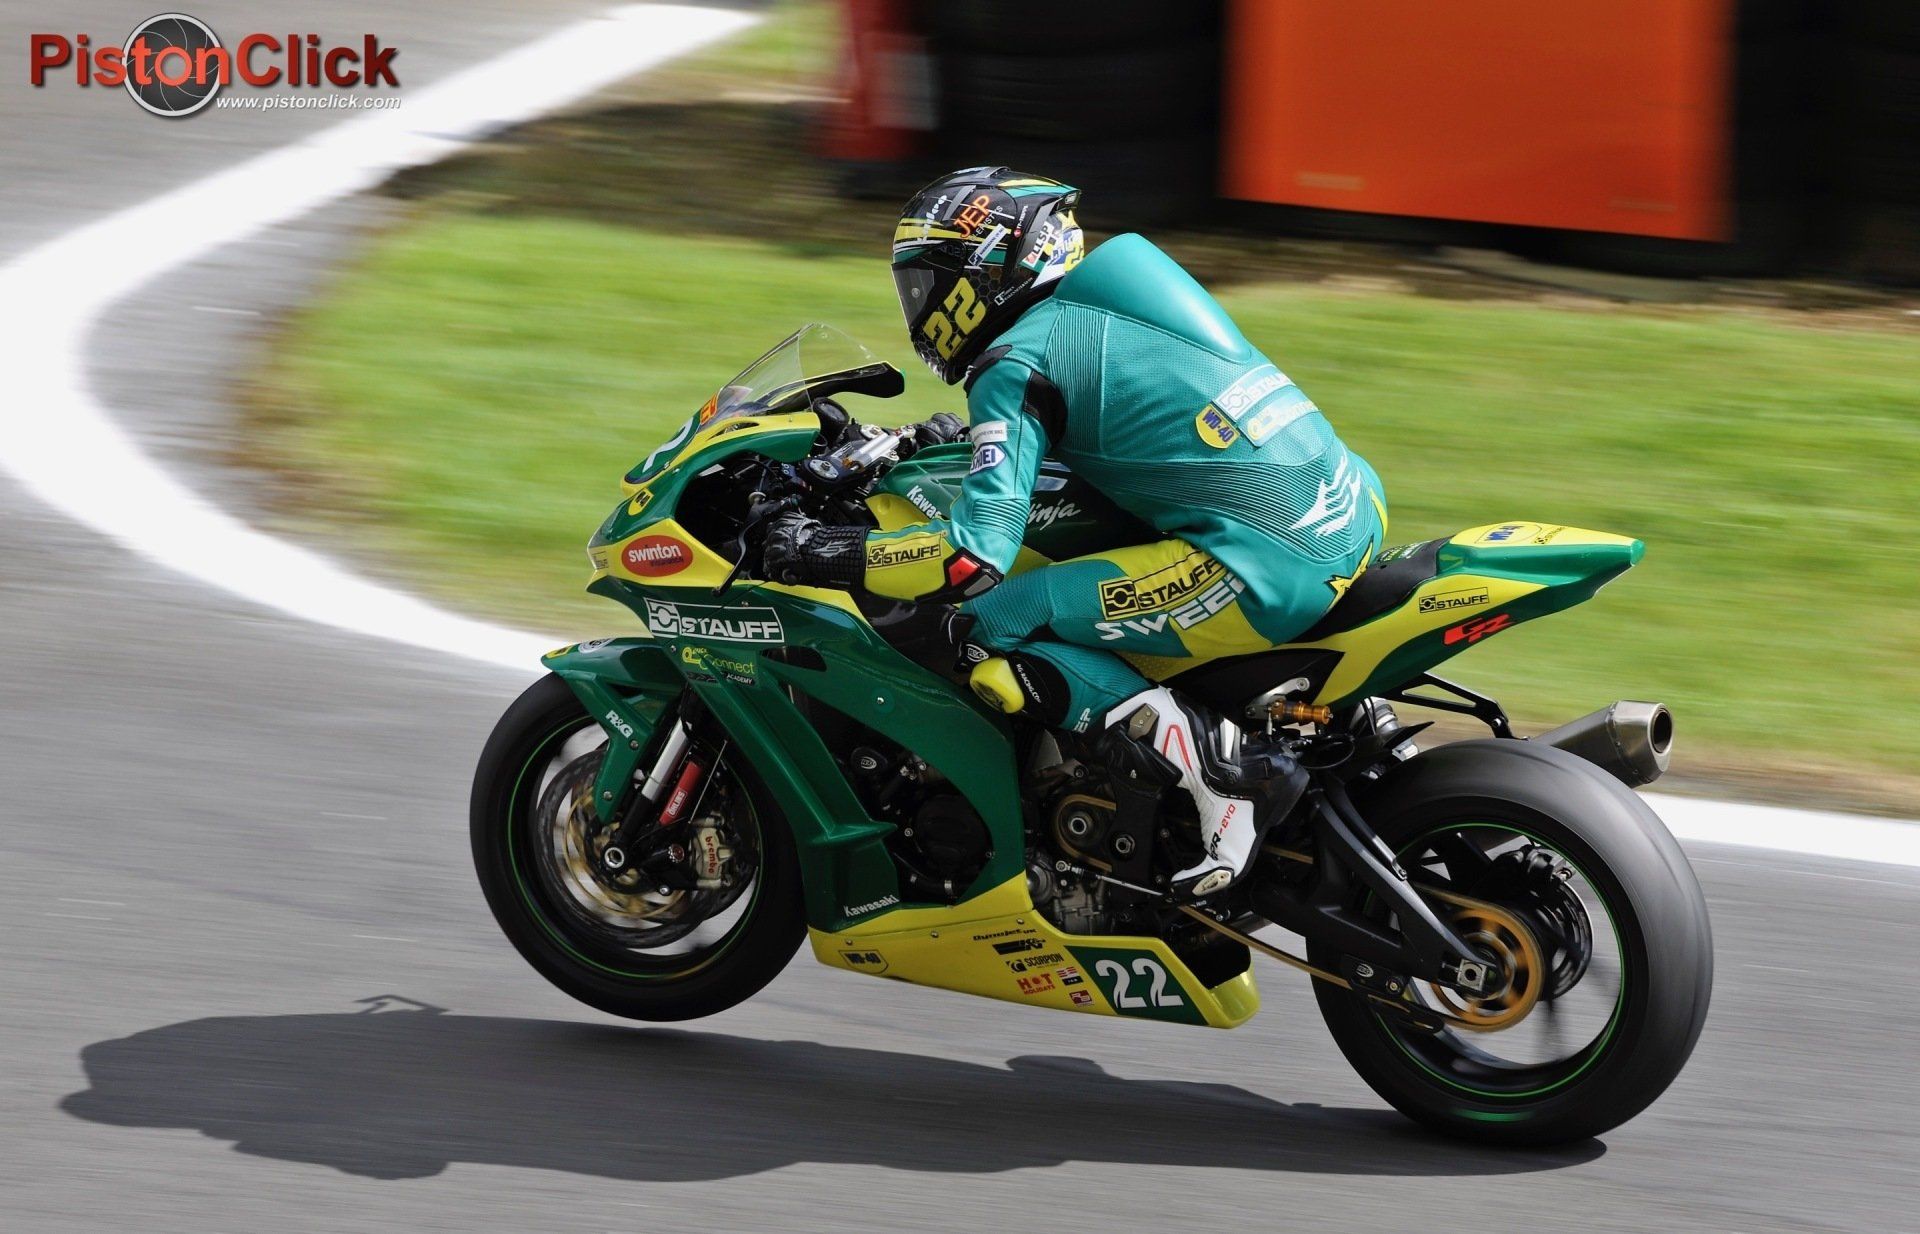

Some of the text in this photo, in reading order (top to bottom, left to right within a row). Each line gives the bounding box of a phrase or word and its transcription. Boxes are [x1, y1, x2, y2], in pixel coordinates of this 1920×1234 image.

[954, 196, 990, 238] JEP
[922, 277, 987, 360] 22
[1202, 409, 1235, 443] WD-40
[628, 544, 682, 562] swinton
[883, 544, 939, 563] STAUFF
[1436, 594, 1488, 609] STAUFF
[681, 616, 780, 639] STAUFF
[605, 710, 634, 738] R&G
[843, 894, 900, 917] Kawasaki
[1024, 953, 1064, 967] SCORPION
[1095, 958, 1184, 1009] 22
